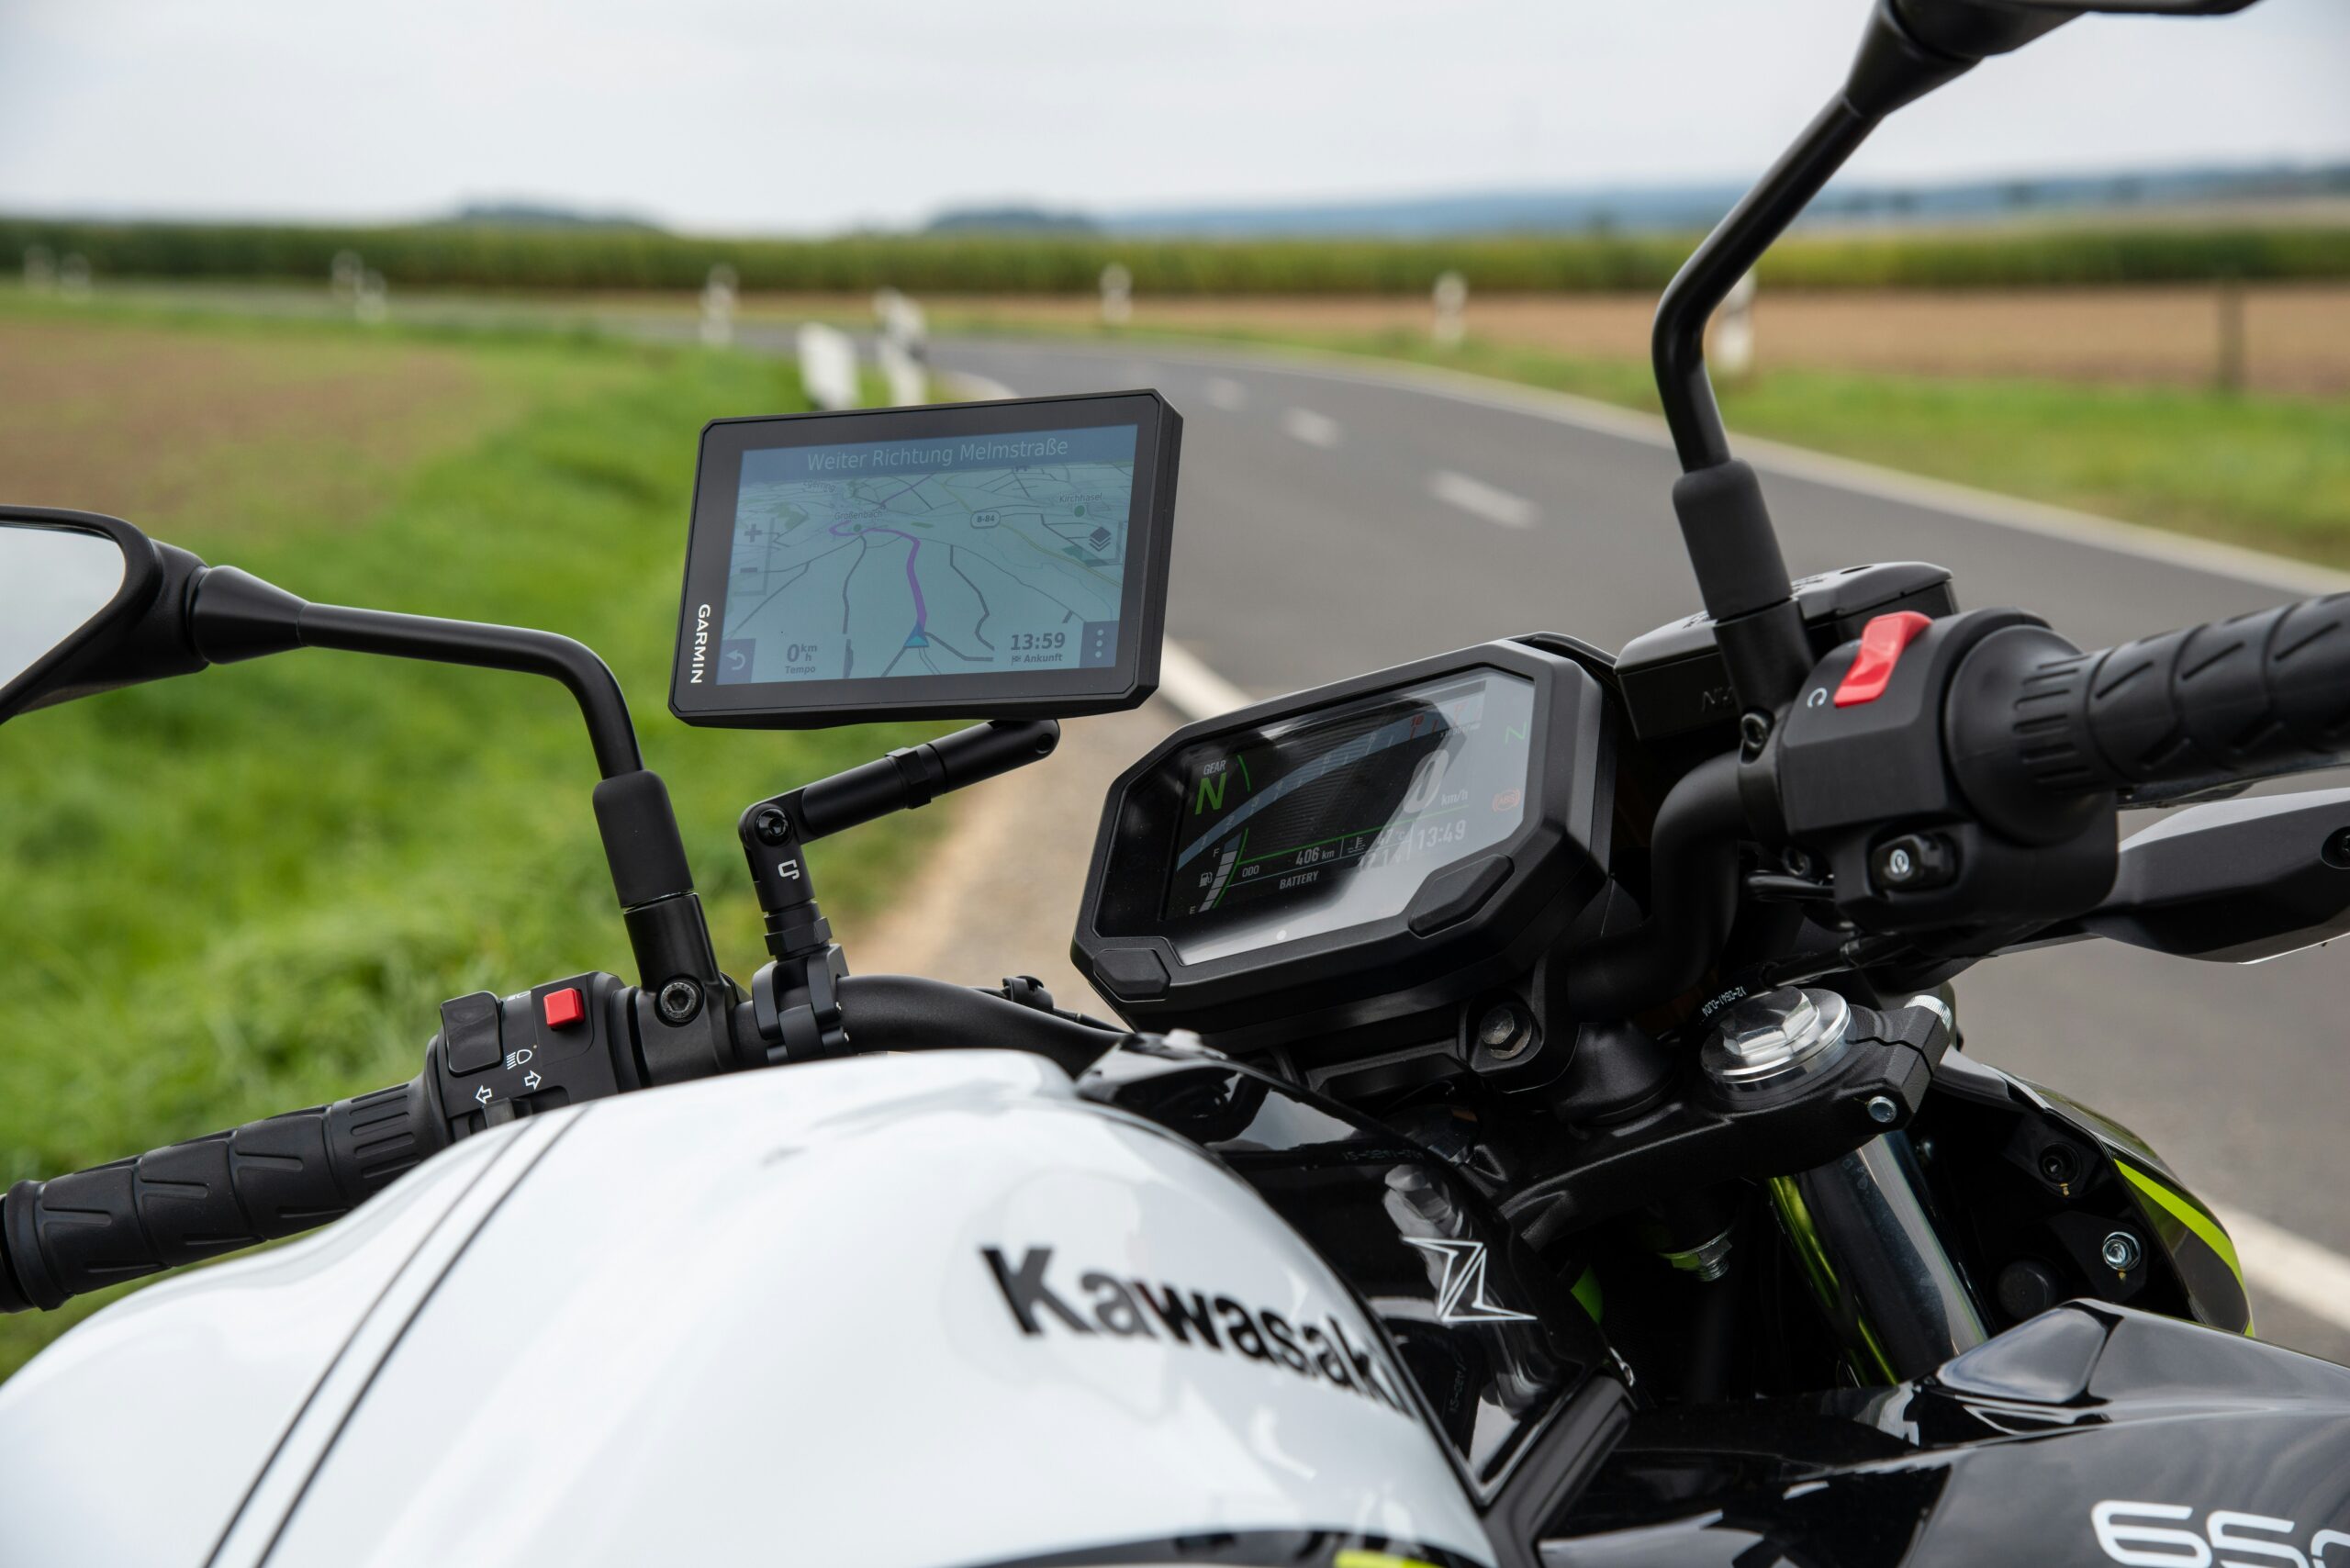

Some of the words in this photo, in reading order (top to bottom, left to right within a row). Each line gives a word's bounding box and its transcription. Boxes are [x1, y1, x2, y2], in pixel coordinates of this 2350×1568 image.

[807, 453, 867, 471] Weiter
[872, 447, 953, 467] Richtung
[959, 438, 1069, 461] Melmstraße
[1058, 492, 1102, 503] Kirchhasel
[834, 510, 883, 521] Großenbach
[690, 603, 711, 684] GARMIN
[1010, 632, 1066, 651] 13:59
[787, 644, 800, 662] 0
[1023, 653, 1063, 663] Ankunft
[785, 666, 816, 675] Tempo
[1203, 760, 1227, 776] GEAR
[1403, 749, 1449, 814] 0
[1440, 789, 1469, 807] km/h
[1195, 772, 1227, 815] N
[1417, 819, 1468, 850] 13:49
[1213, 847, 1220, 858] F
[1241, 864, 1260, 879] ODO
[1295, 846, 1320, 866] 406
[1321, 849, 1335, 860] km
[1278, 869, 1320, 890] BATTERY
[979, 1247, 1418, 1421] Kawasak
[2090, 1499, 2350, 1568] 65
